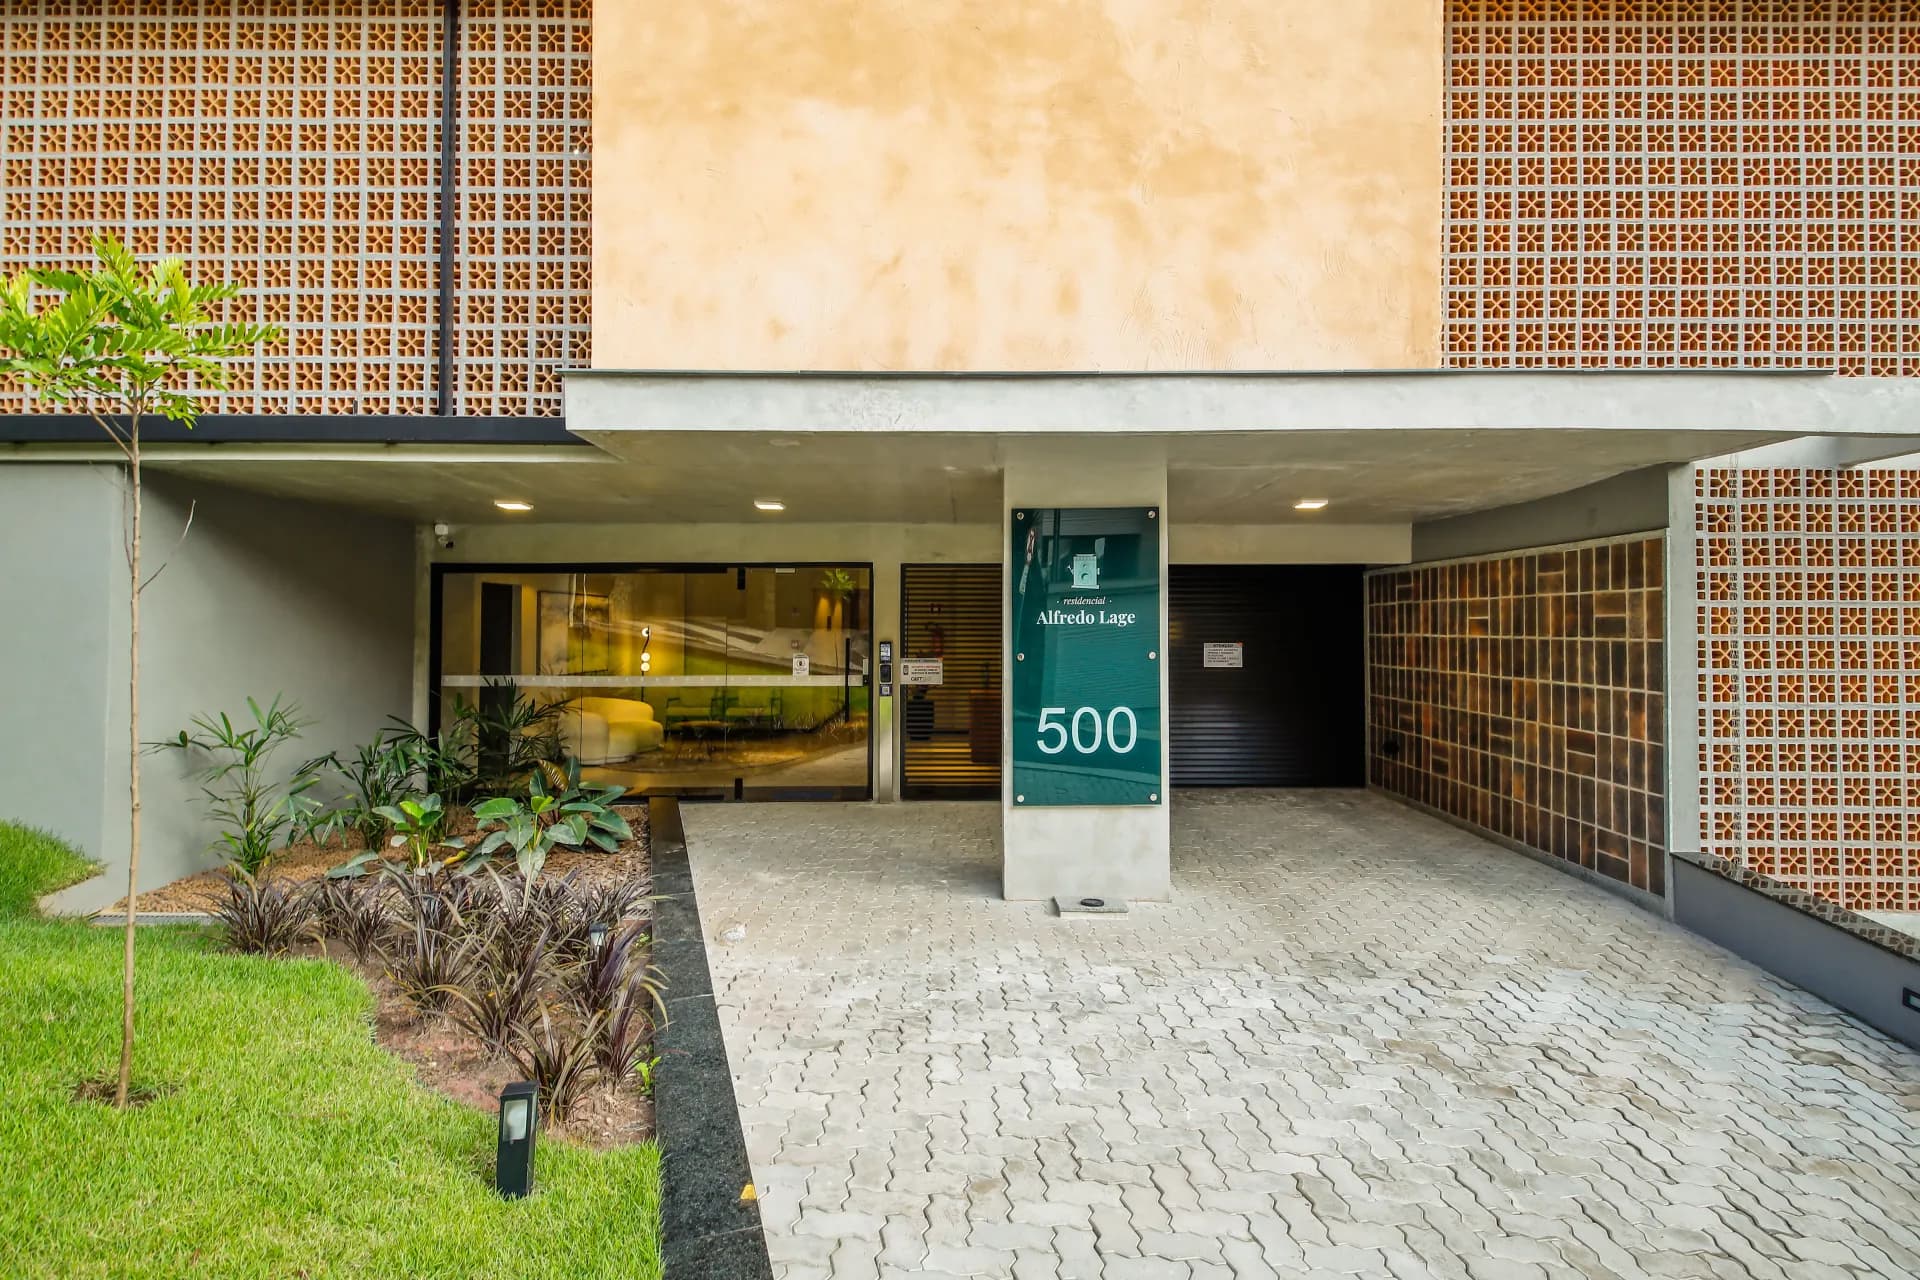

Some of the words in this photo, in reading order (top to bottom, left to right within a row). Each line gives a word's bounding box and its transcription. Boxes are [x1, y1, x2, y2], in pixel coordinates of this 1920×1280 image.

[1063, 596, 1105, 605] residencial
[1036, 609, 1095, 625] Alfredo
[1099, 610, 1136, 627] Lage
[1036, 706, 1137, 755] 500
